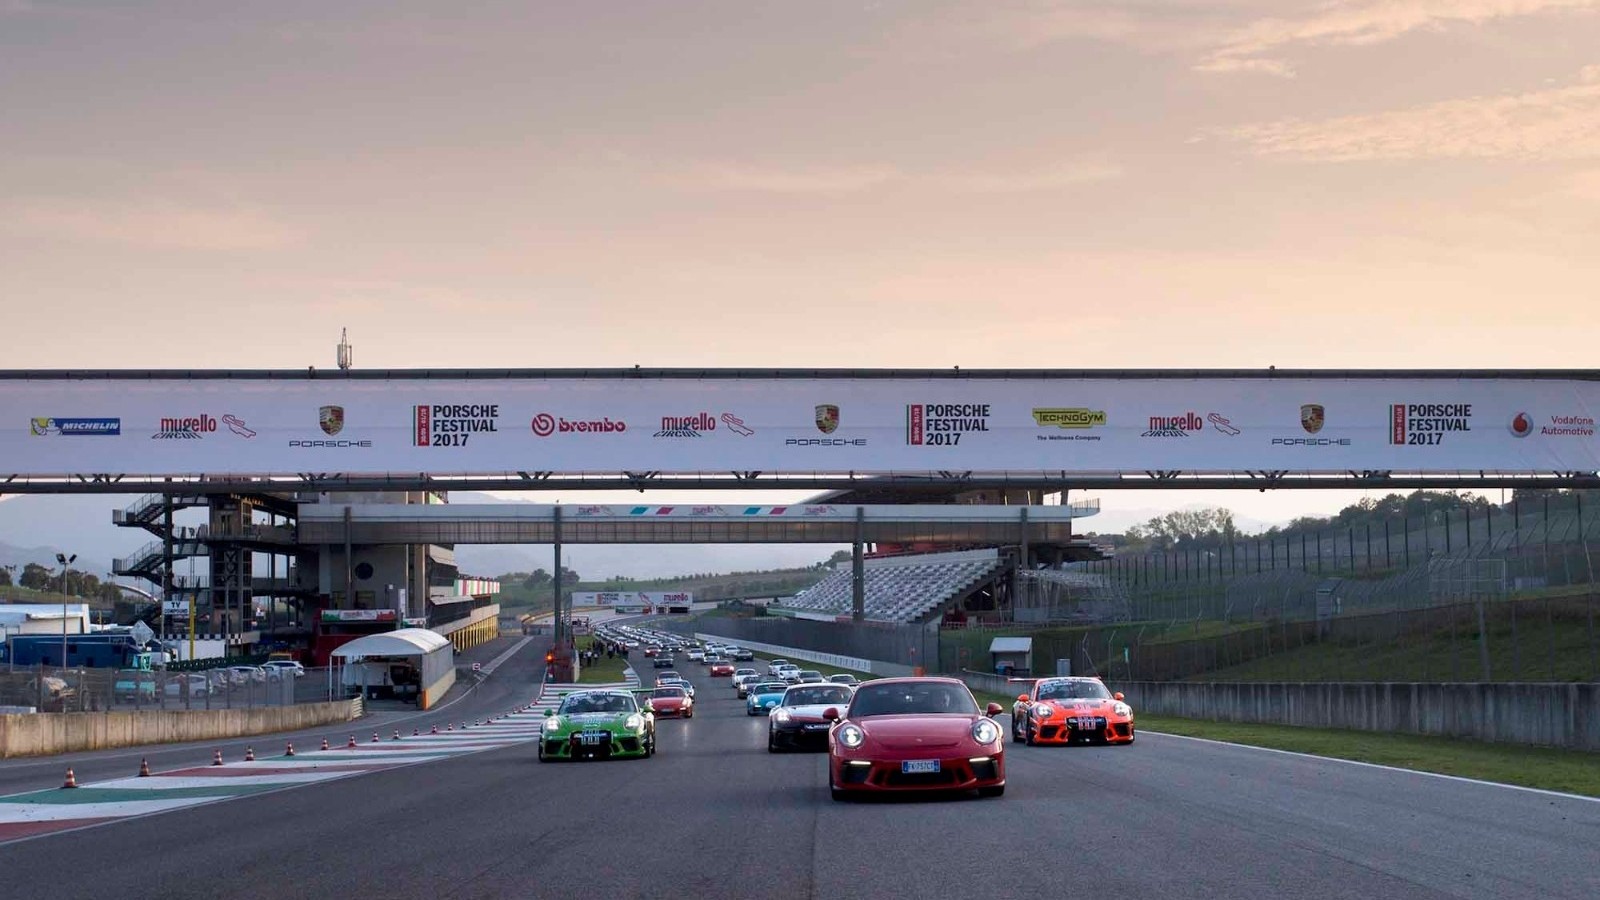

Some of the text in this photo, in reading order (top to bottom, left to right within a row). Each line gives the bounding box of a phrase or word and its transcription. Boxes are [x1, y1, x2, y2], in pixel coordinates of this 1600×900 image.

[433, 405, 499, 418] PORSCHE
[926, 404, 991, 417] PORSCHE
[1409, 404, 1472, 417] PORSCHE
[62, 422, 119, 430] MICHELIN
[161, 414, 217, 432] mugello
[433, 419, 498, 432] FESTIVAL
[558, 418, 626, 433] brembo
[662, 412, 716, 431] mugello
[926, 418, 989, 431] FESTIVAL
[1150, 412, 1203, 431] mugello
[1409, 418, 1471, 431] FESTIVAL
[1551, 415, 1594, 425] Vodafone
[1541, 426, 1594, 436] Automotive
[432, 433, 469, 447] 2017
[926, 433, 961, 446] 2017
[1408, 432, 1444, 445] 2017
